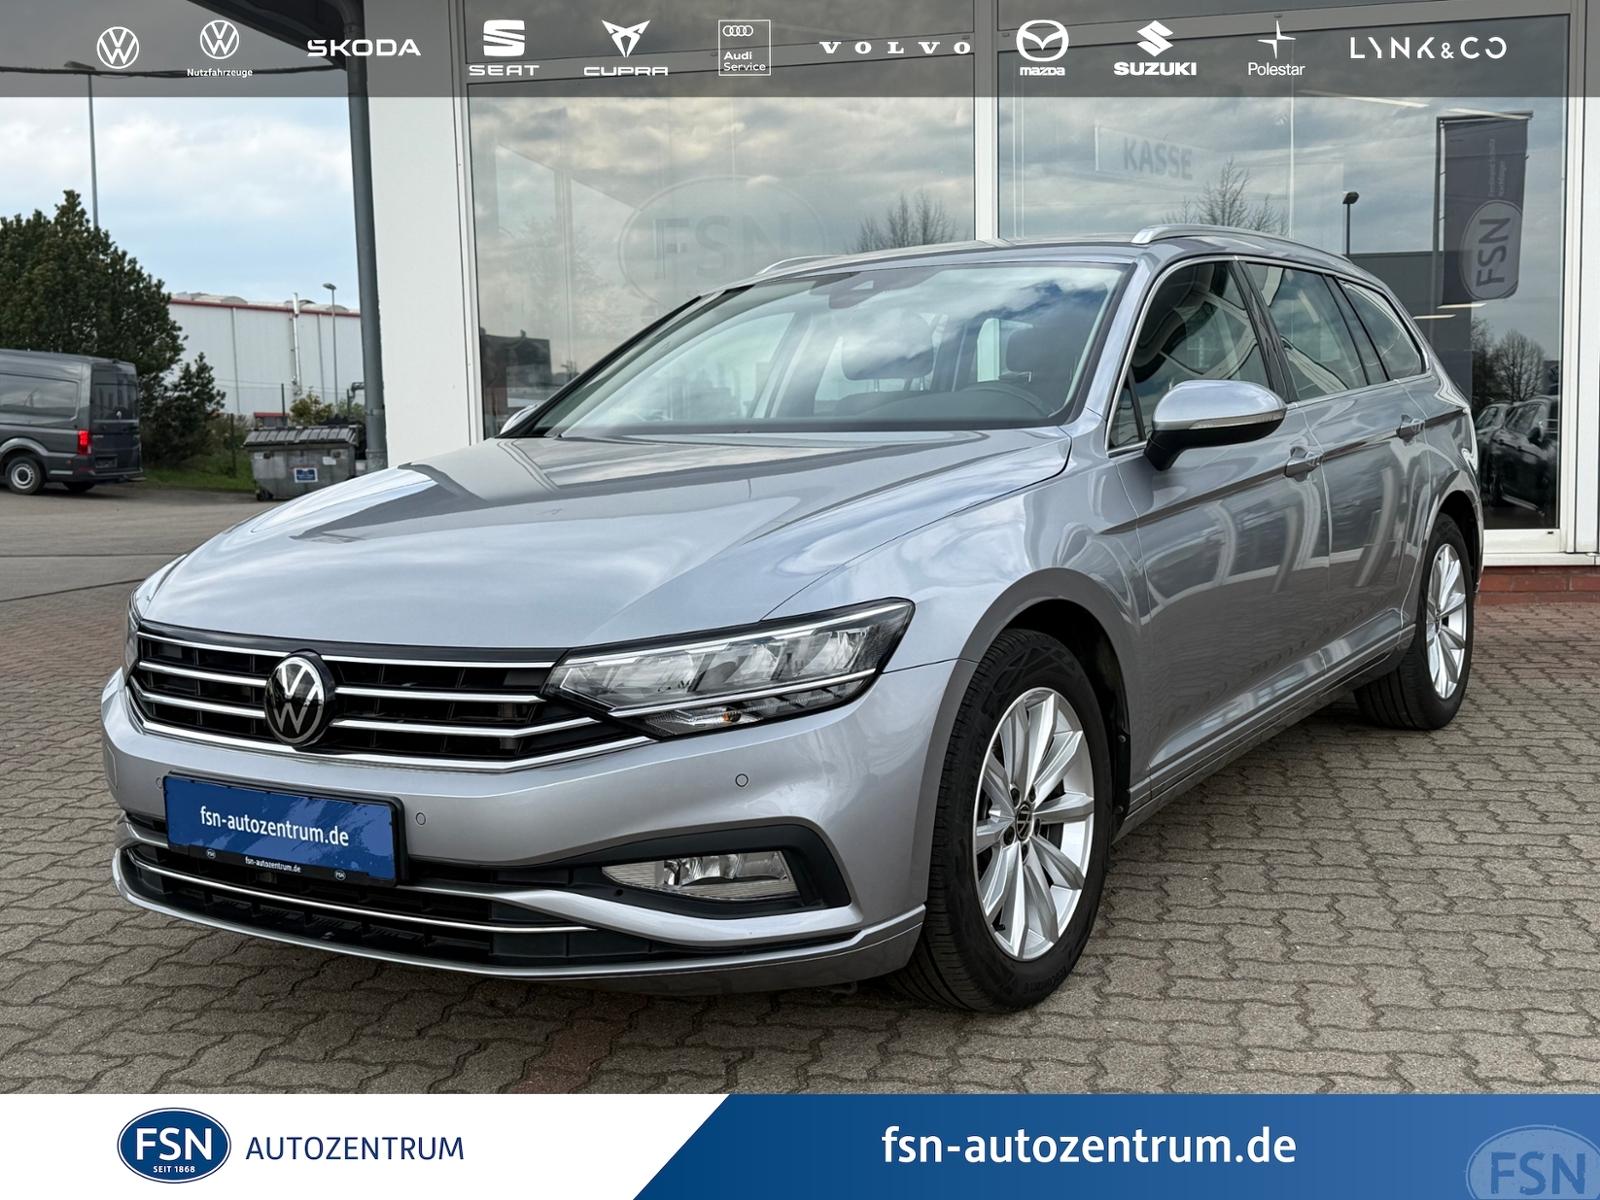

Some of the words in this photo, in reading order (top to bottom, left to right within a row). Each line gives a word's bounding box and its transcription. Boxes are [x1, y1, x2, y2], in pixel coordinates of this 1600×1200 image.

[1123, 137, 1193, 181] KASSE
[1475, 217, 1511, 287] FSN
[200, 806, 349, 847] fsn-autozentrum.de
[244, 856, 302, 873] fsn-autozentrum.de
